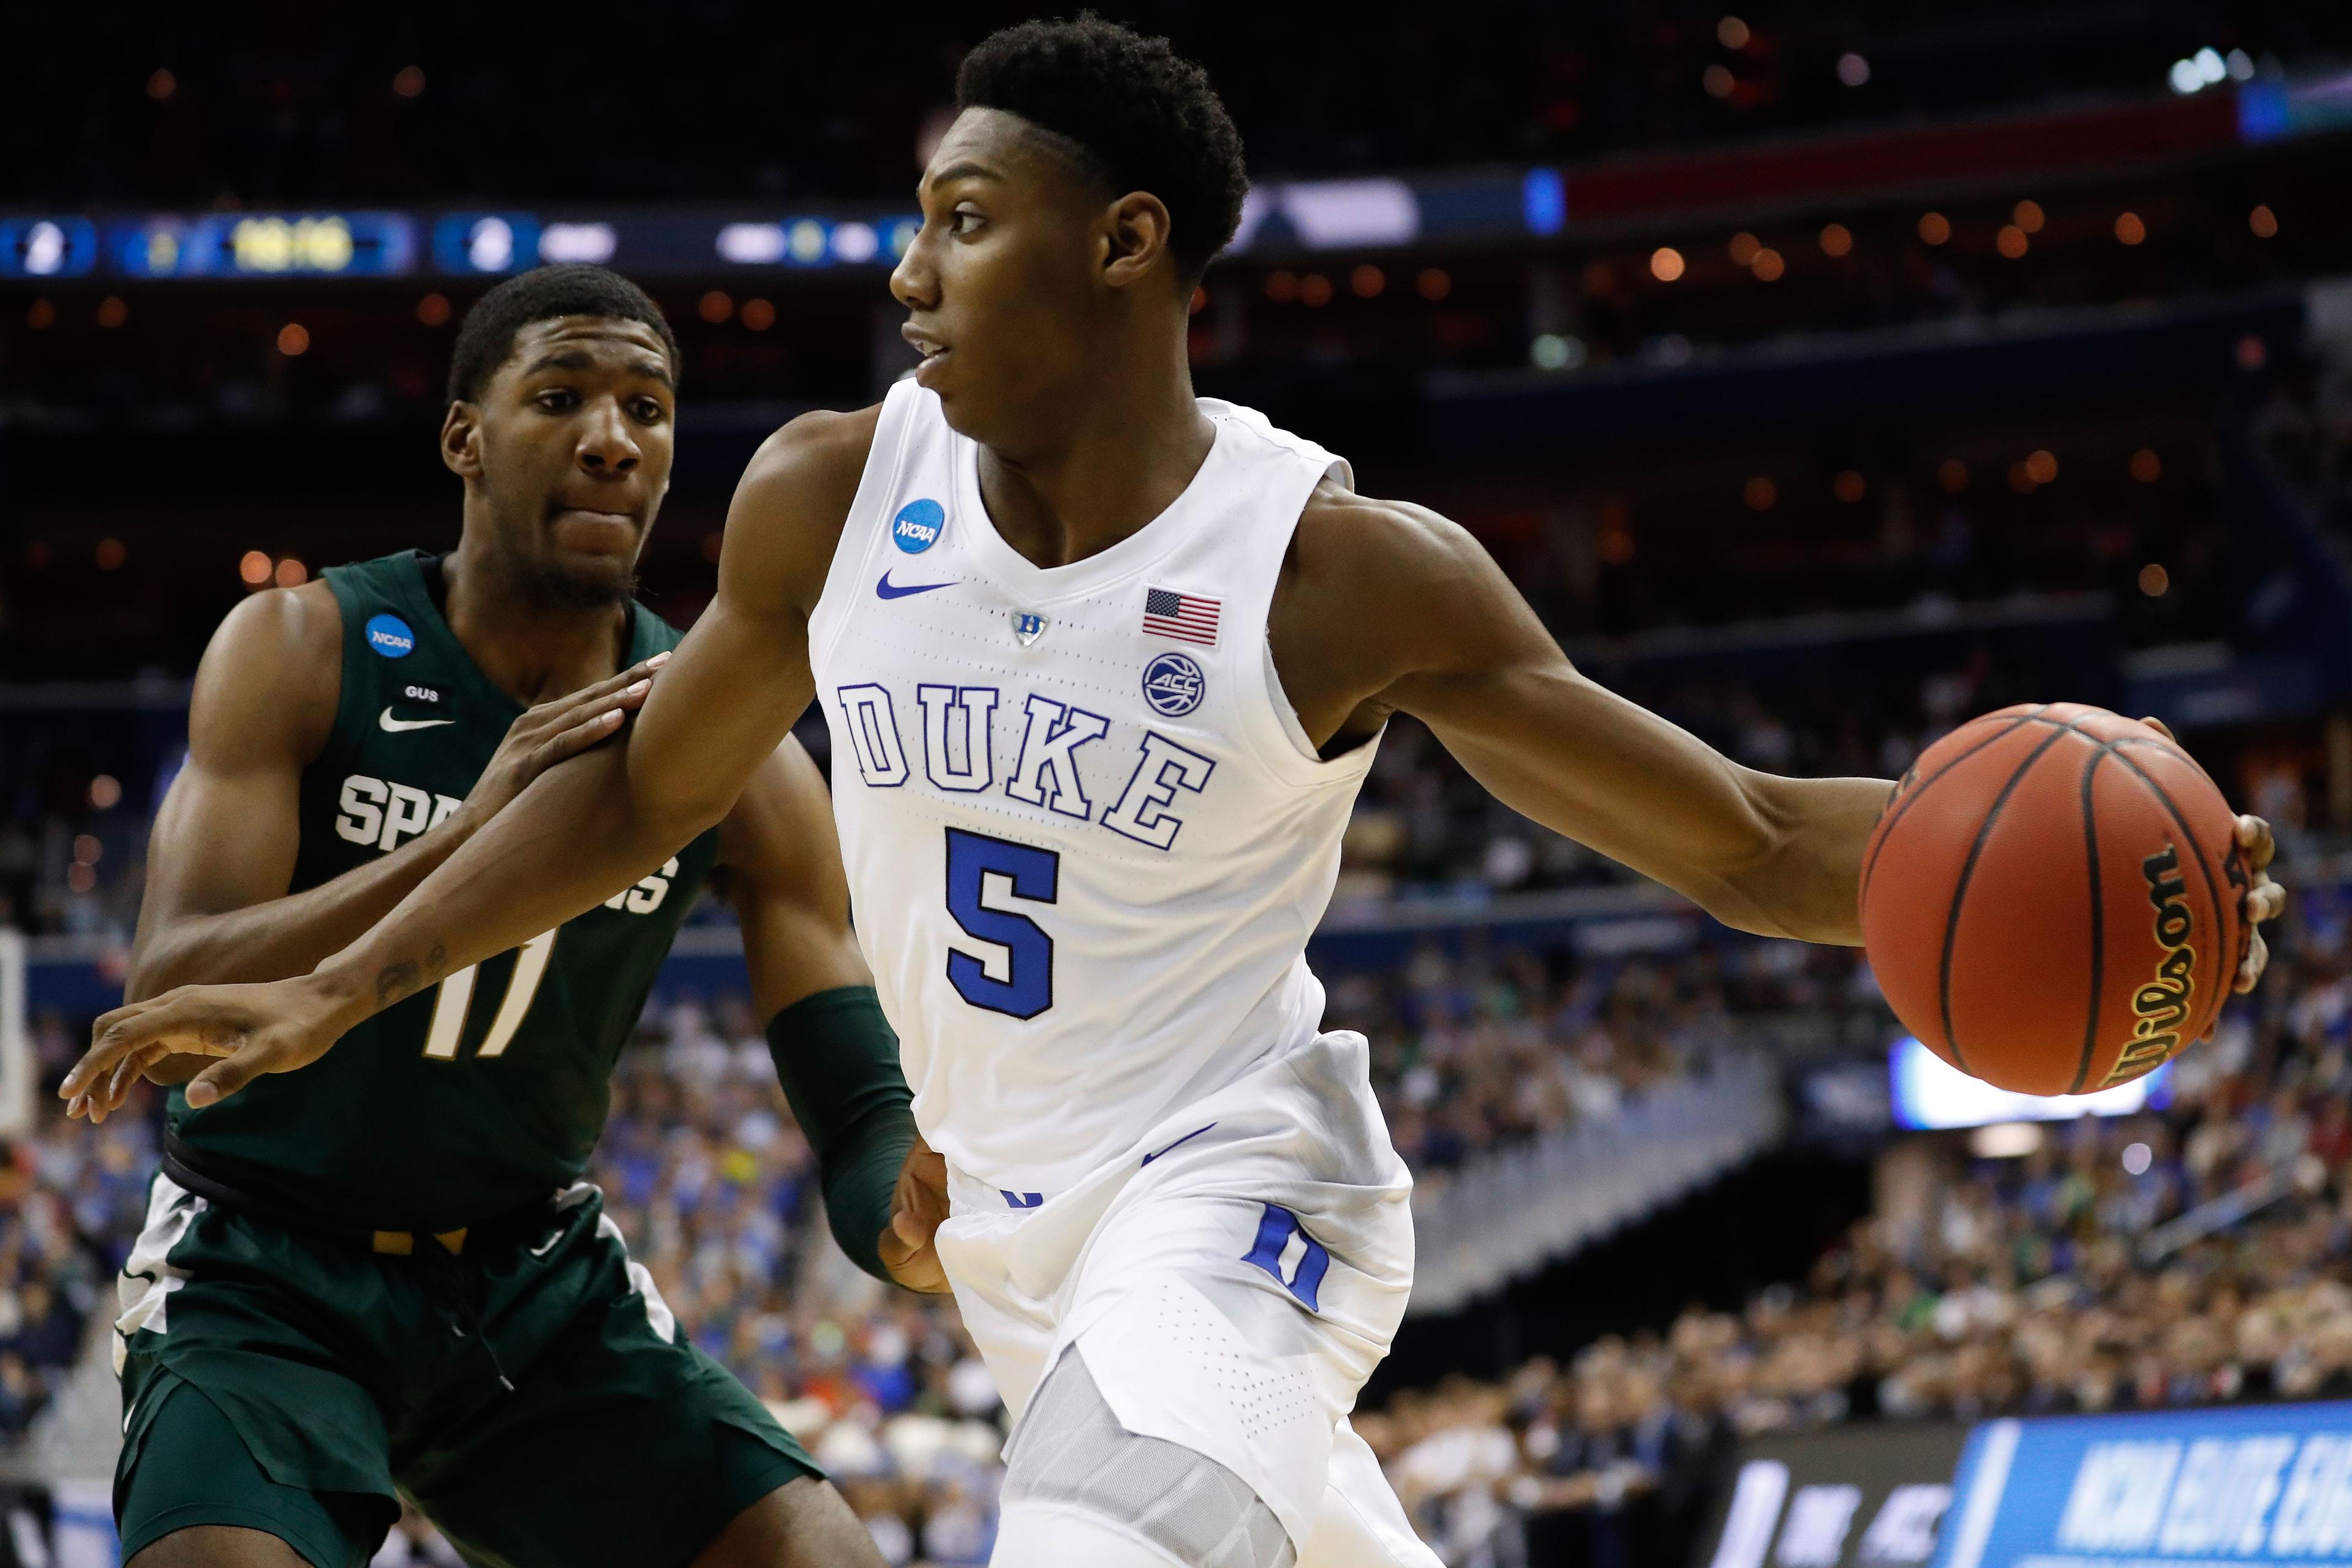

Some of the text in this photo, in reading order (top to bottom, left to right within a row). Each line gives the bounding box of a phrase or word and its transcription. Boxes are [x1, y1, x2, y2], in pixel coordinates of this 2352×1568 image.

[895, 520, 936, 543] NCAA
[373, 630, 412, 649] NCAA
[1151, 673, 1201, 692] ACC
[405, 685, 439, 703] GUS
[837, 682, 1216, 851] DUKE
[945, 826, 1060, 1020] 5
